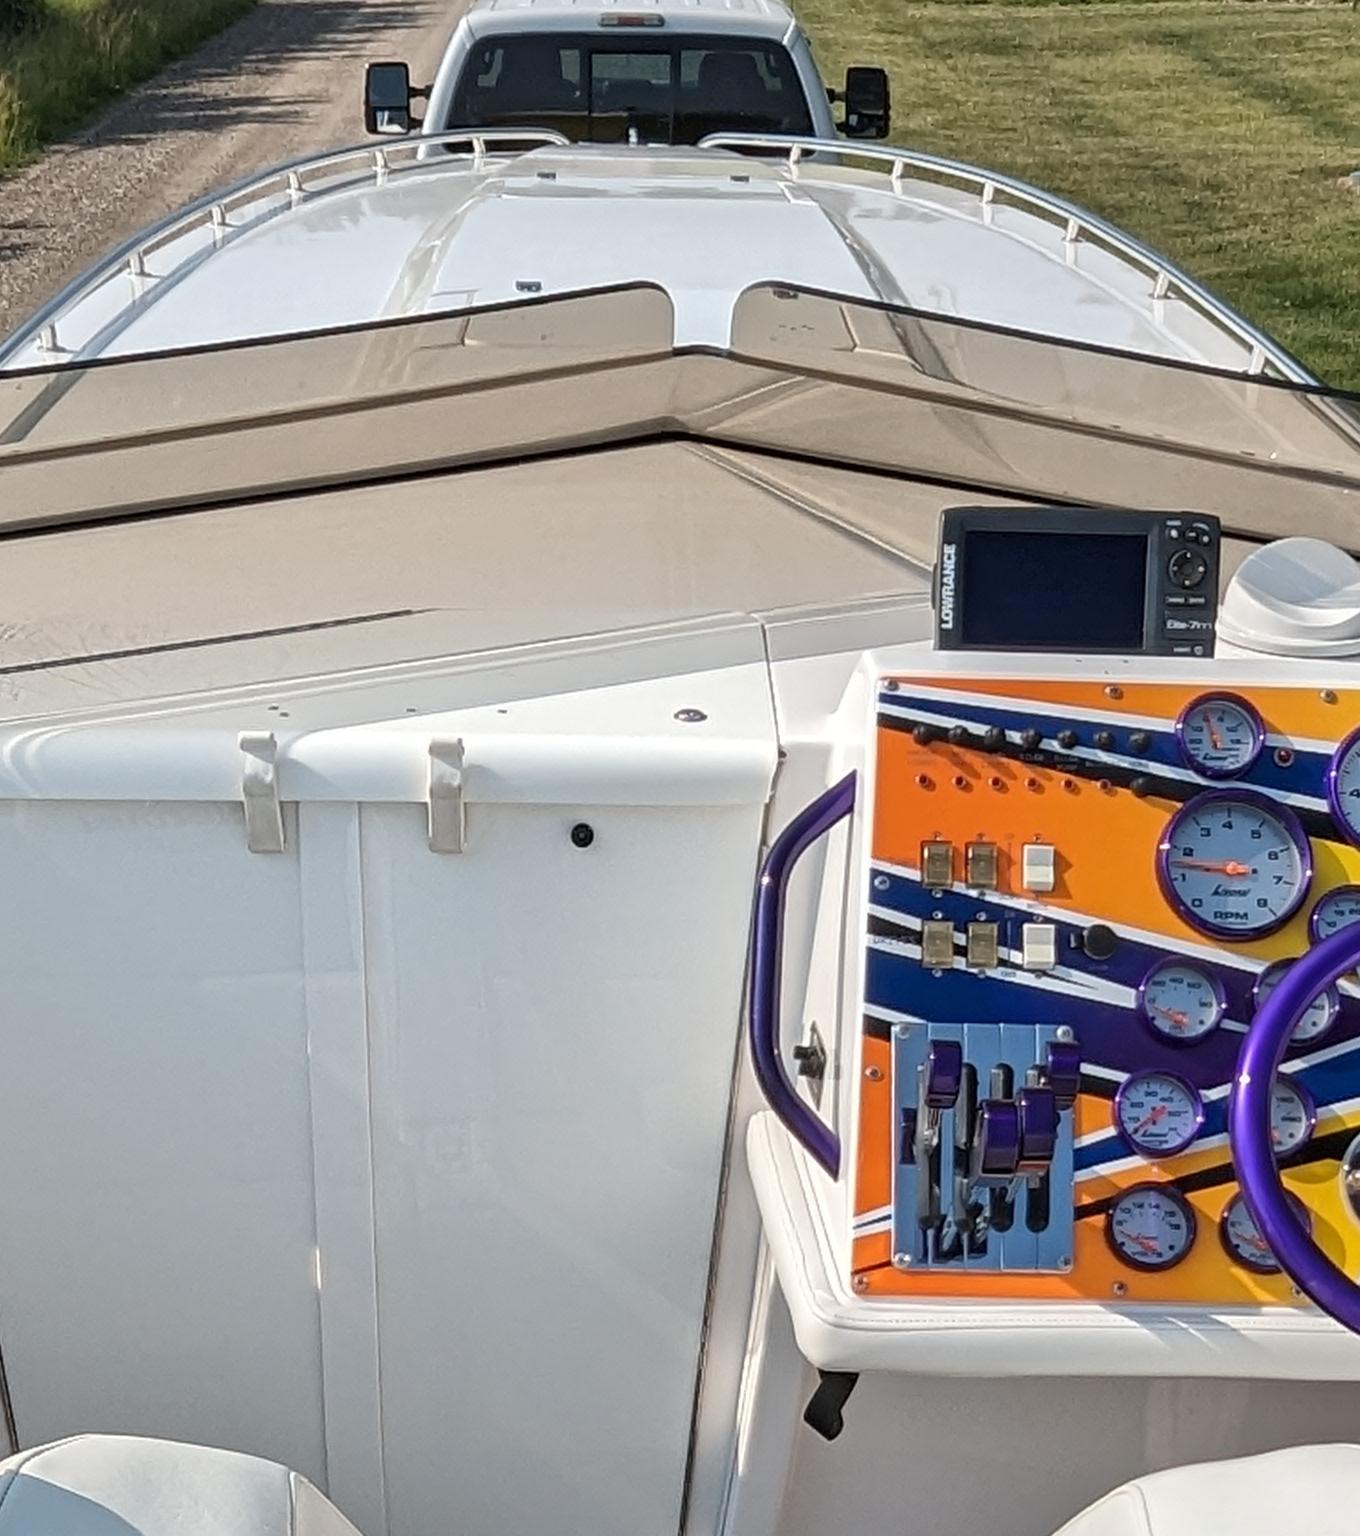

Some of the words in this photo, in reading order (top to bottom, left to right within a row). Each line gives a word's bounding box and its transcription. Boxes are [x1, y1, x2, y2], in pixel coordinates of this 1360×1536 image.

[941, 544, 956, 629] LOWRANCE
[1349, 788, 1360, 799] 4
[1222, 821, 1233, 830] 4
[1200, 827, 1211, 837] 3
[1251, 829, 1262, 839] 5
[1183, 847, 1194, 857] 2
[1268, 851, 1279, 860] 6
[1273, 875, 1283, 885] 7
[1192, 898, 1203, 908] 0
[1214, 911, 1248, 920] RPM
